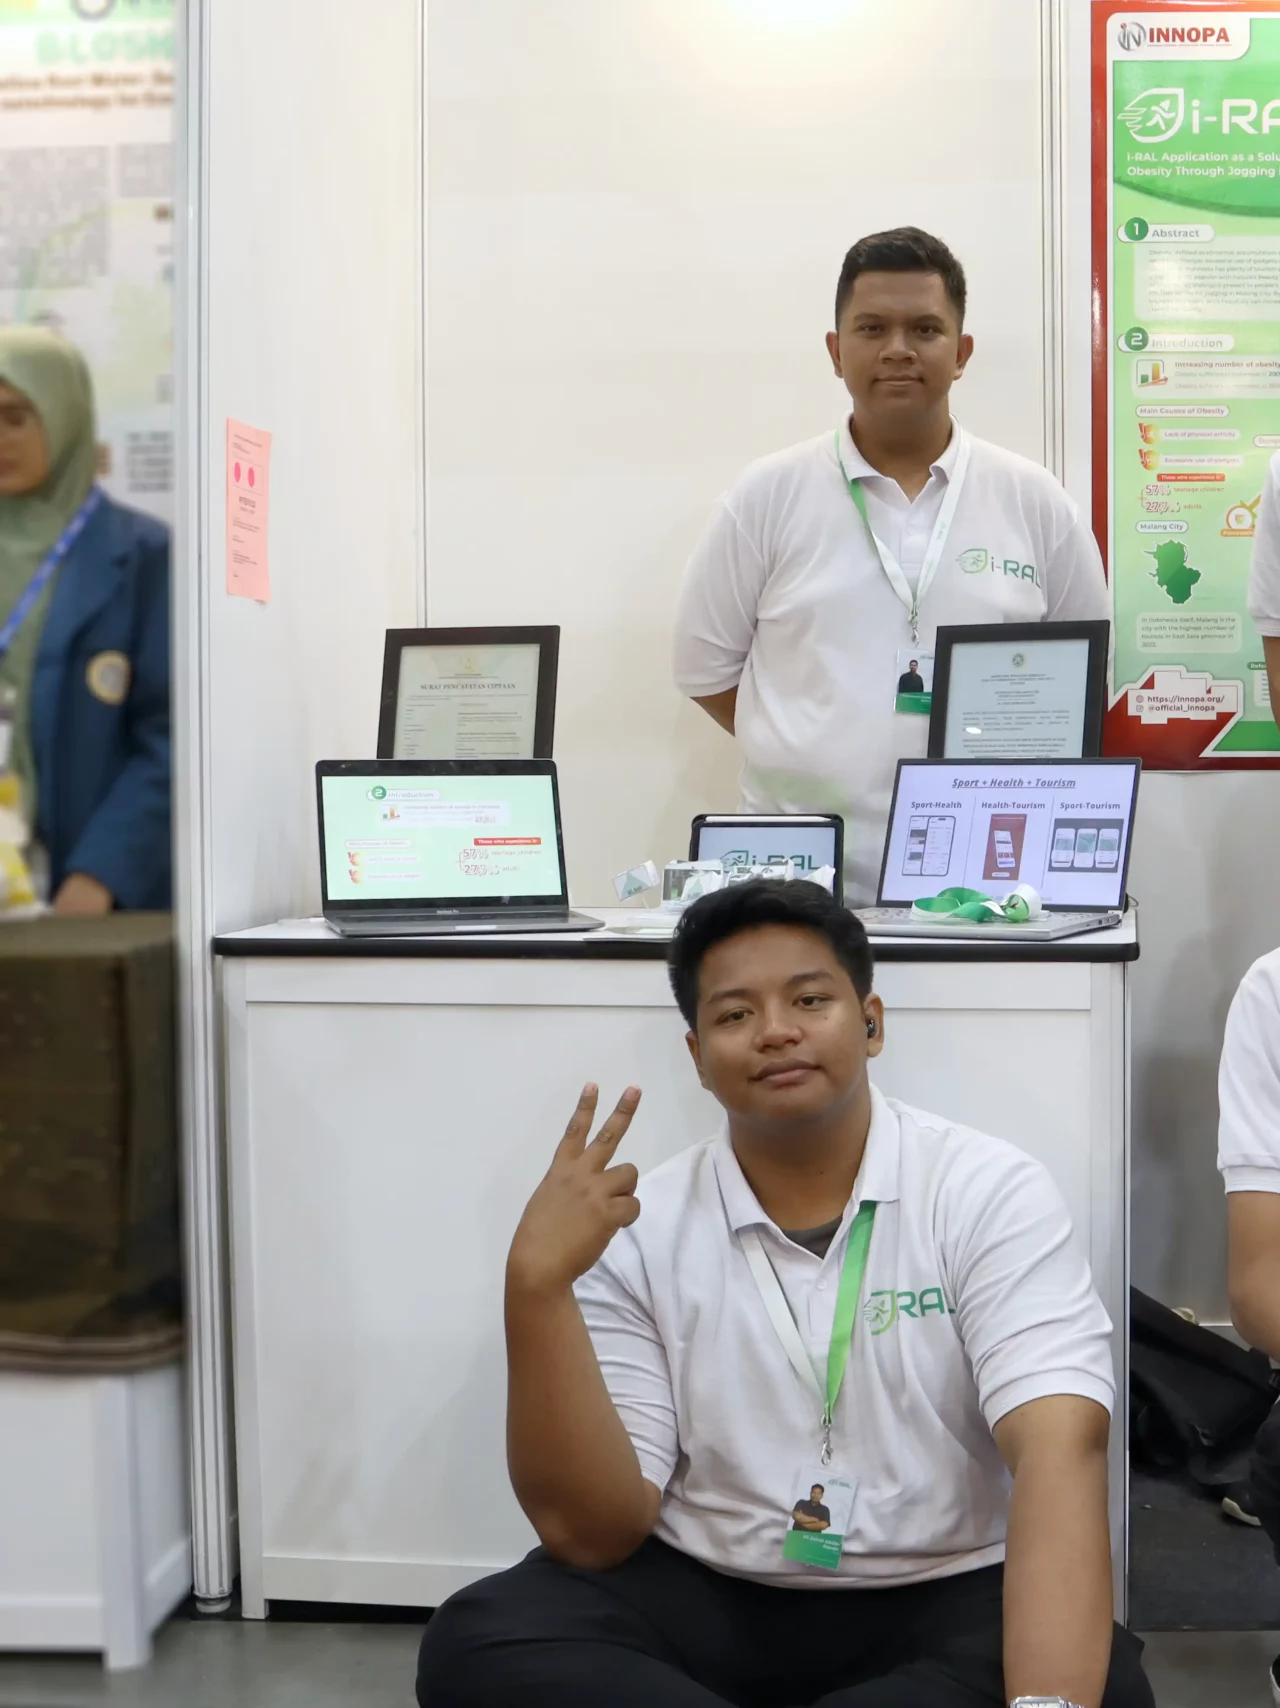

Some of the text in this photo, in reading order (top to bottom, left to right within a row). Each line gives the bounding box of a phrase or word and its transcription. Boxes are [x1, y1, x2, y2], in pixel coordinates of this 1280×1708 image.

[1149, 27, 1230, 43] INNOPA
[1161, 152, 1229, 164] Application
[1232, 154, 1245, 162] as
[1248, 154, 1254, 162] a
[1127, 166, 1172, 178] Obesity
[1175, 166, 1225, 178] Through
[1228, 166, 1275, 178] Jogging
[1133, 223, 1200, 238] 1 Abstract
[1131, 333, 1223, 348] 2 Introduction
[1175, 361, 1213, 369] Increasing
[1255, 361, 1280, 369] obesity
[1140, 407, 1225, 416] Main Causes of Obesity
[1140, 523, 1184, 531] Malang City
[952, 778, 980, 788] Sport
[991, 778, 1024, 788] Health
[1035, 778, 1076, 788] Tourism
[376, 788, 383, 797] 2
[911, 801, 1121, 811] Sport-Health Health-Tourism Sport-Tourism
